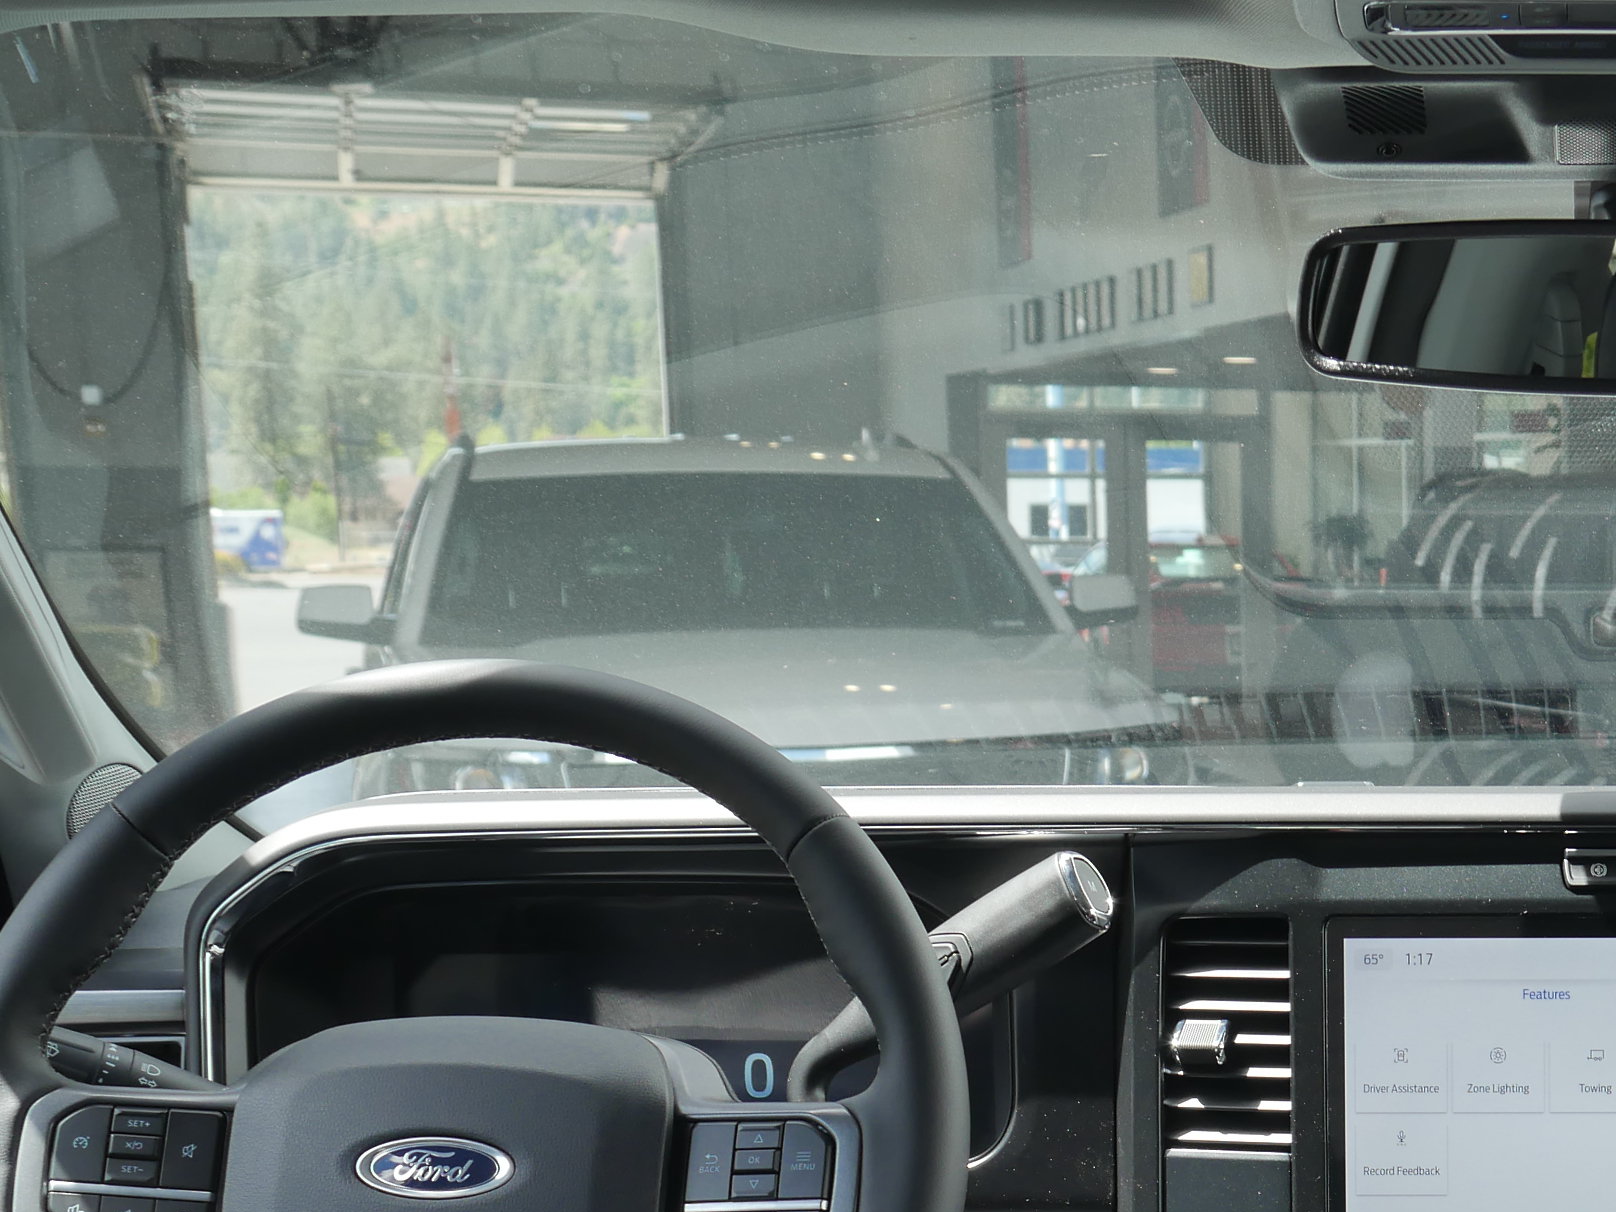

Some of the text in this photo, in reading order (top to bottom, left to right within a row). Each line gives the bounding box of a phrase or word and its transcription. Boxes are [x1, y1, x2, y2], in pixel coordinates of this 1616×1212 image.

[1363, 952, 1384, 965] 65°
[1405, 952, 1433, 966] 1:17
[1522, 988, 1571, 1001] Features
[744, 1052, 774, 1098] 0
[1363, 1082, 1440, 1094] Driver Assistance
[1466, 1082, 1530, 1097] Zone Lighting
[1579, 1082, 1613, 1097] Towing
[393, 1149, 474, 1183] Ford
[748, 1156, 760, 1165] OK
[699, 1166, 720, 1174] BACK
[790, 1163, 816, 1172] MENU
[1363, 1165, 1441, 1177] Record Feedback
